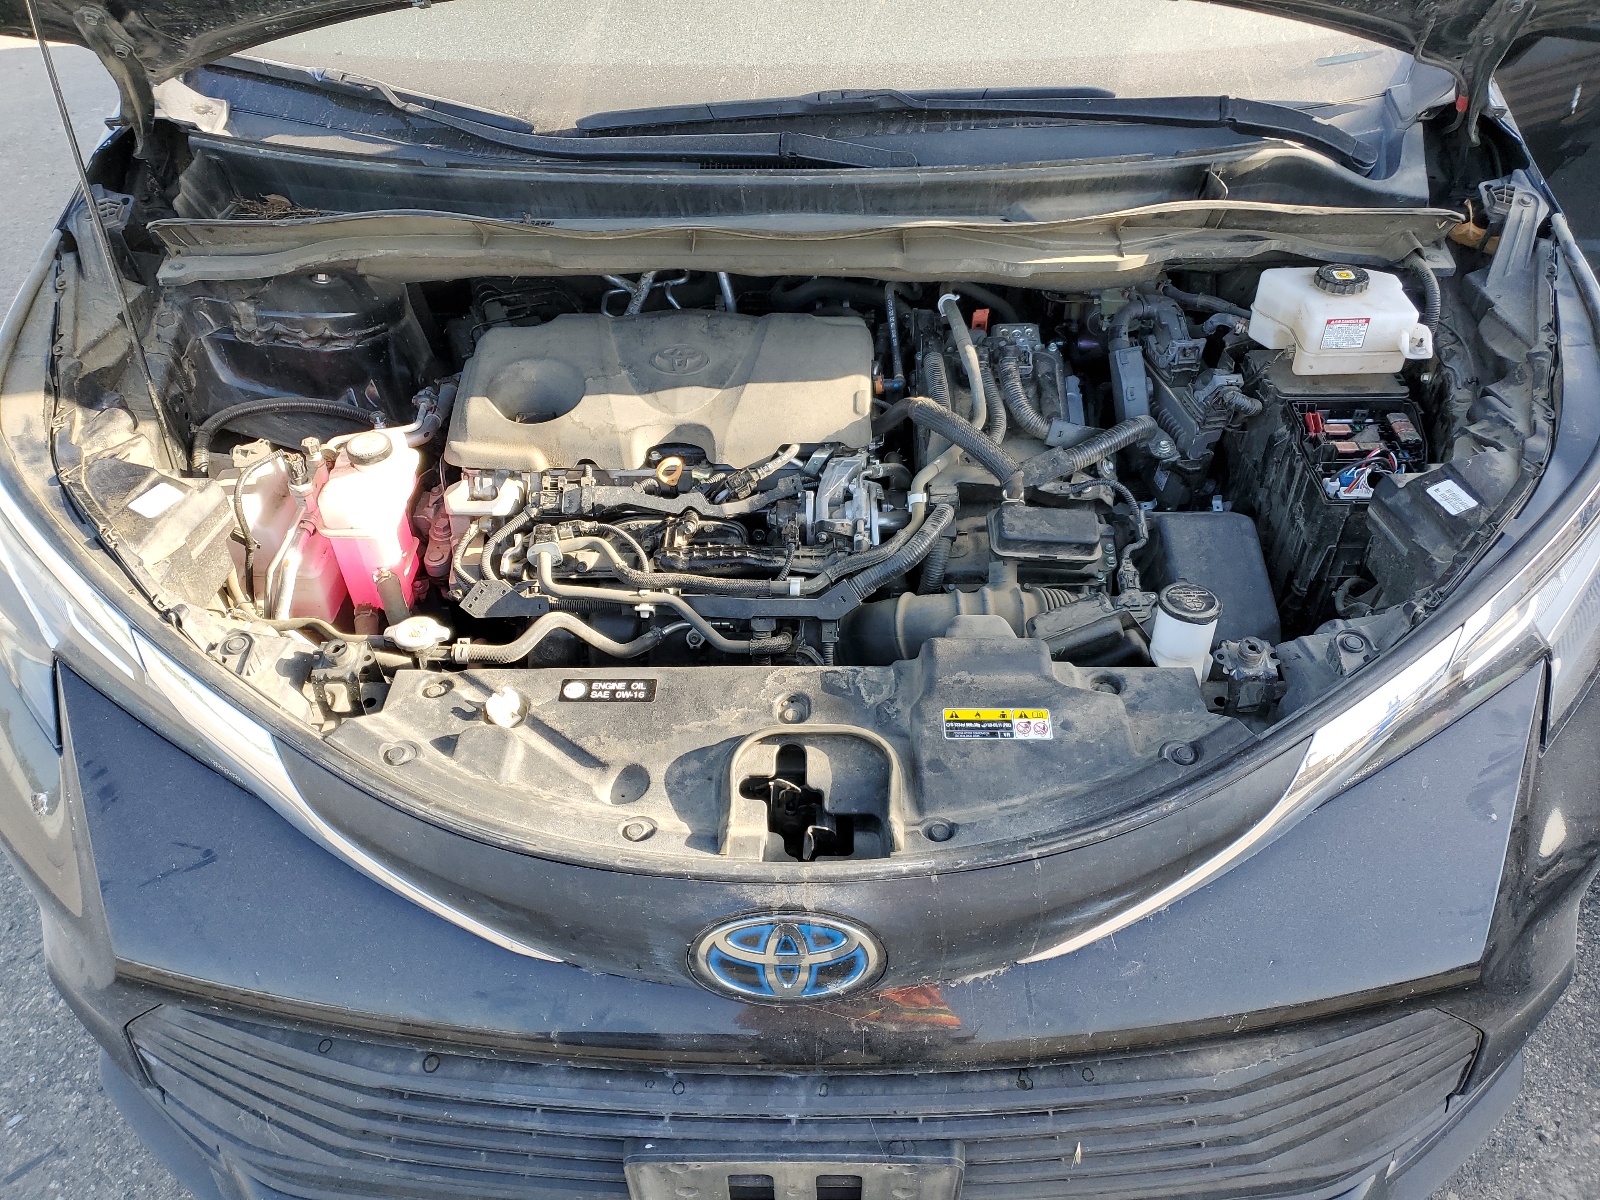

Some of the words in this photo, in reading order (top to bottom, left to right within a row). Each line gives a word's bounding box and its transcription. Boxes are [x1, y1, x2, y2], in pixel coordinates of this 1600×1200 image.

[591, 682, 626, 690] ENGINE
[630, 682, 646, 690] OIL
[590, 691, 610, 699] SAE
[615, 691, 645, 699] 0W-16
